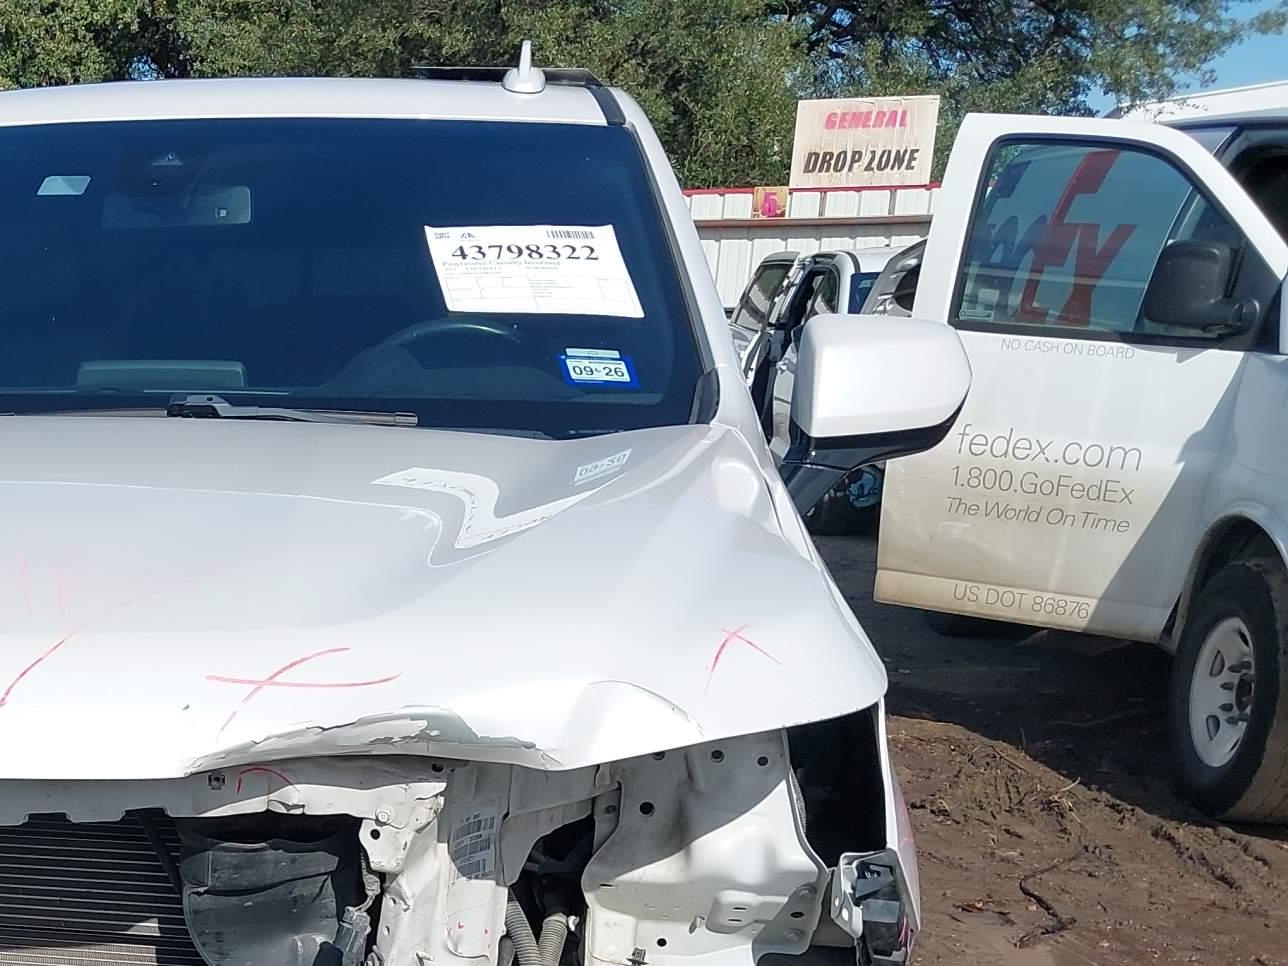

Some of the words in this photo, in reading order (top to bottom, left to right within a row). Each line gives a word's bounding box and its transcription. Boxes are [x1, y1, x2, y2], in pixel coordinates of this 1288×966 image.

[824, 110, 908, 130] GENERAL
[803, 150, 861, 174] DROP
[864, 148, 920, 172] ZONE
[451, 244, 599, 261] 43798322
[1000, 338, 1021, 351] NO
[1024, 340, 1059, 354] CASH
[1063, 342, 1083, 356] ON
[1087, 344, 1136, 359] BOARD
[958, 424, 1142, 471] fedex.com
[952, 465, 1136, 504] 1.800.GoFedEx
[947, 496, 979, 516] The
[983, 501, 1042, 523] World
[1046, 508, 1076, 526] On
[1081, 511, 1130, 533] Time
[953, 583, 980, 602] US
[985, 588, 1028, 608] DOT
[1031, 595, 1090, 619] 86876
